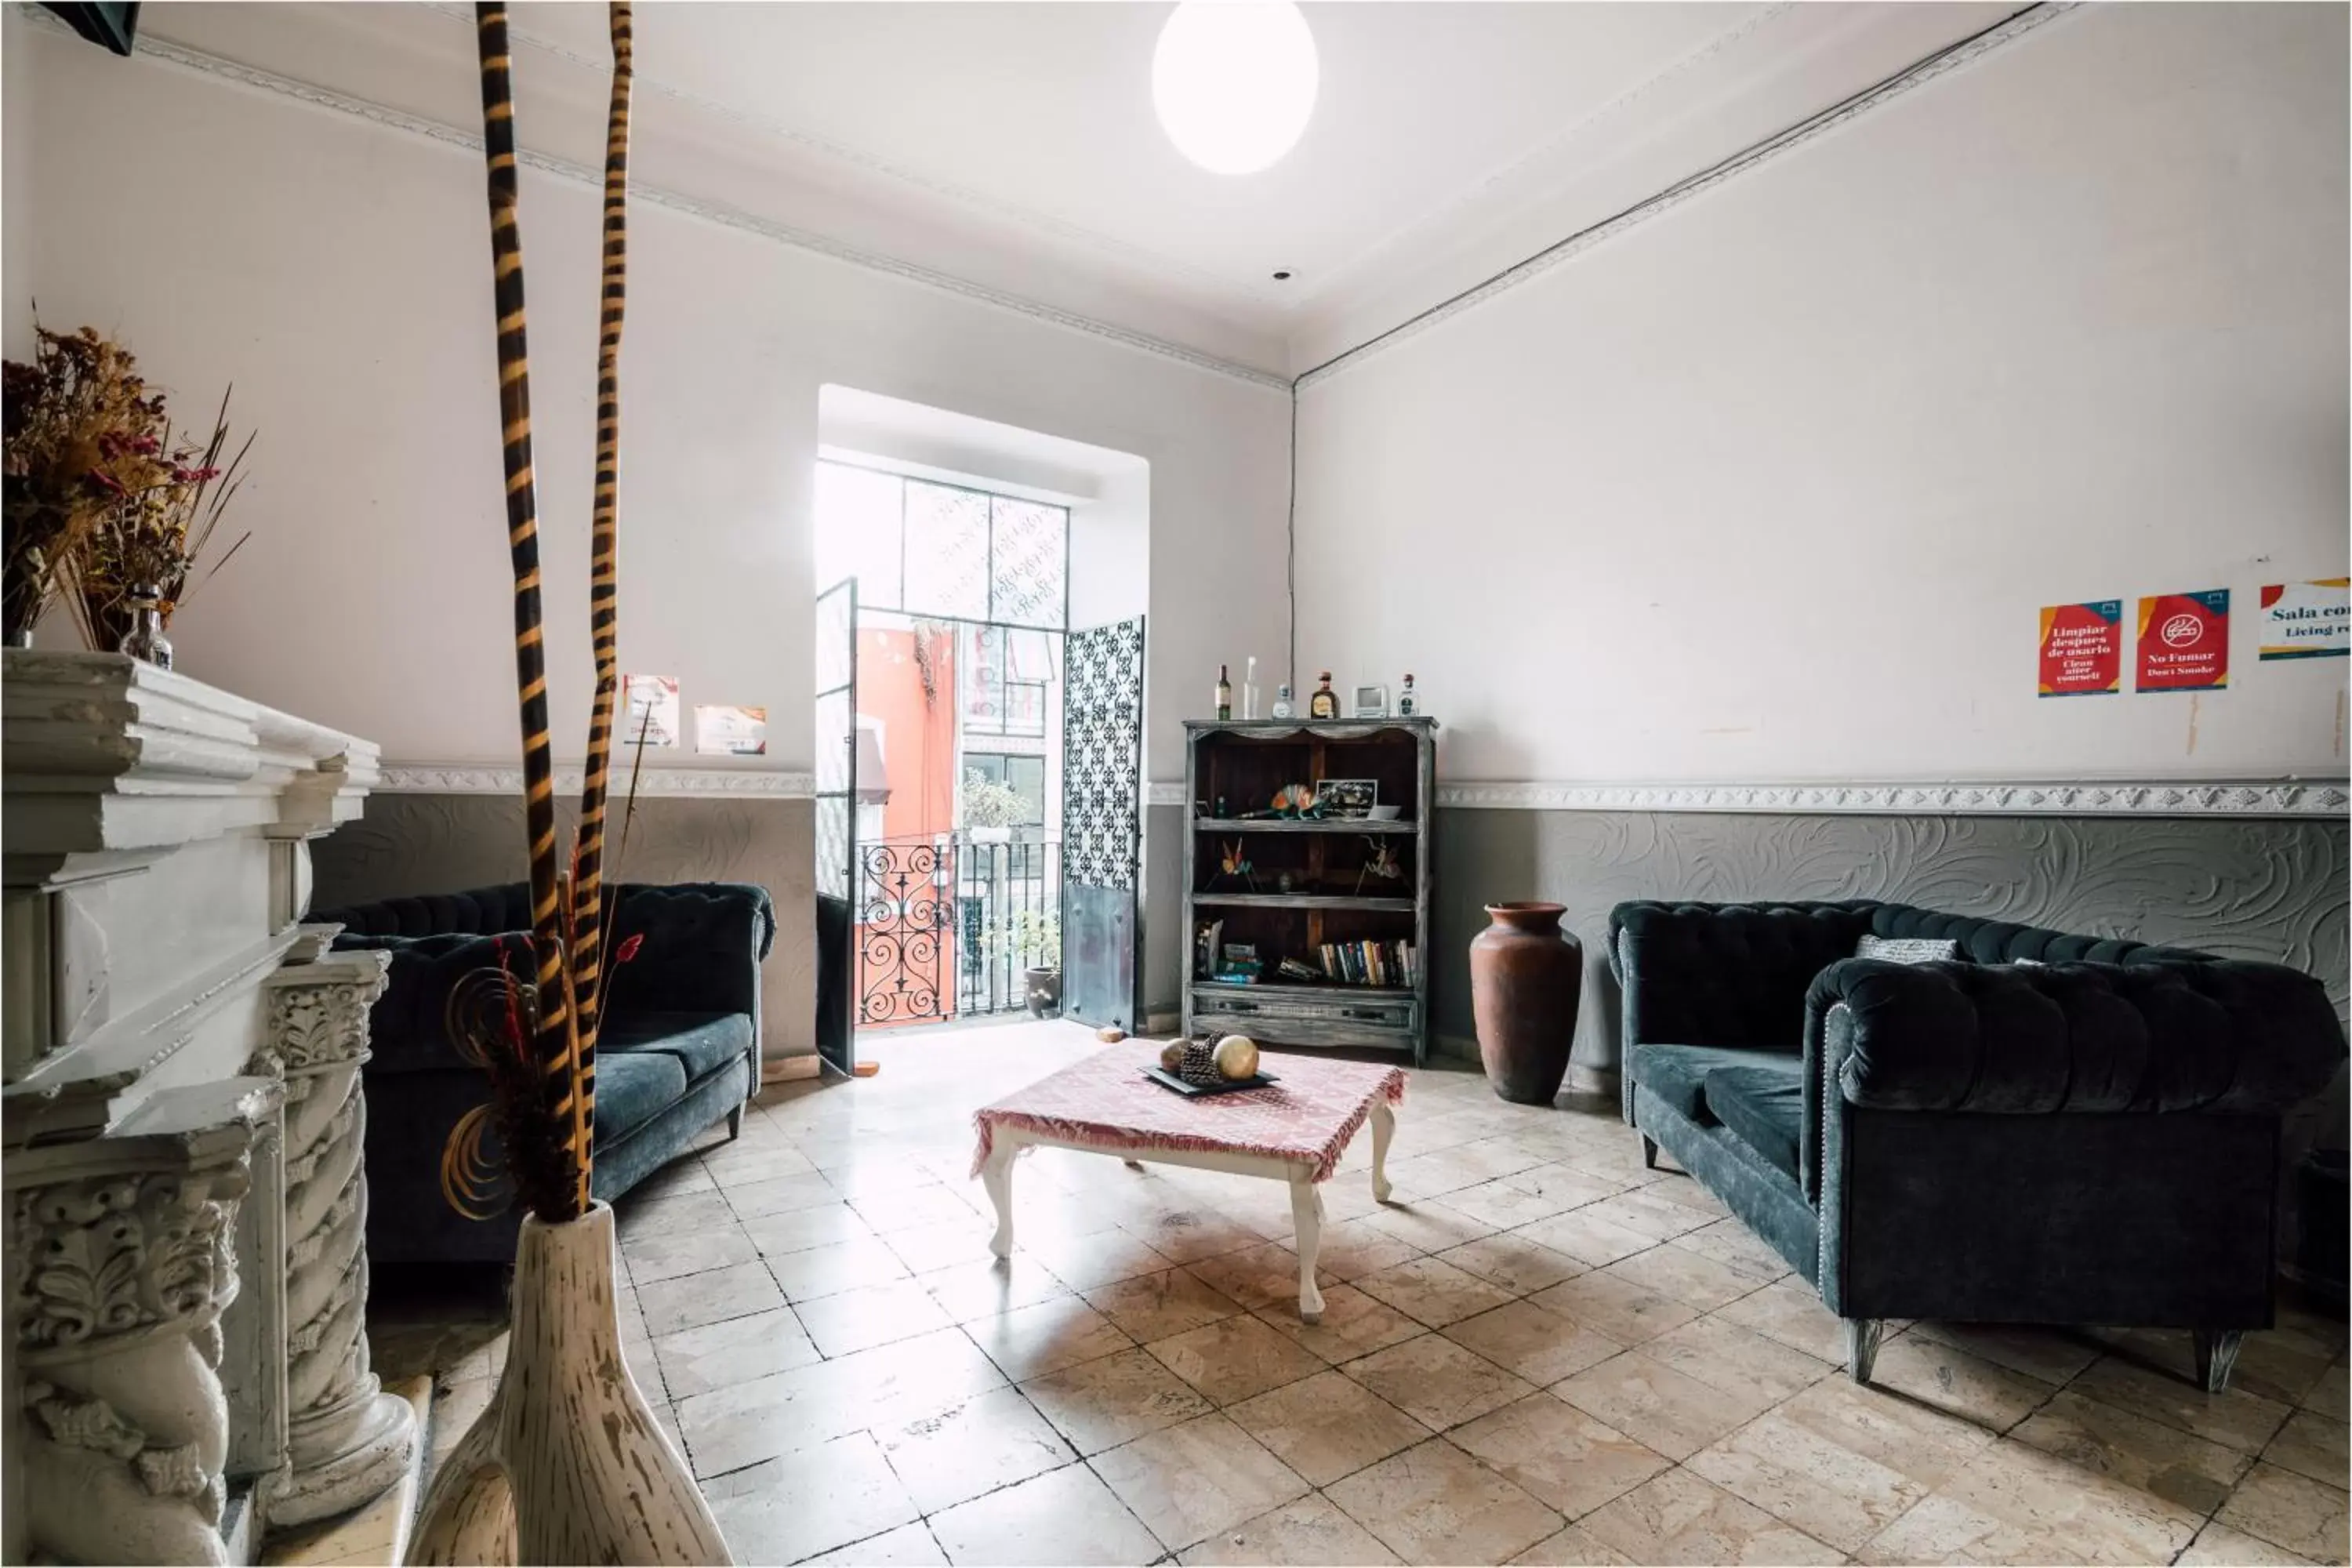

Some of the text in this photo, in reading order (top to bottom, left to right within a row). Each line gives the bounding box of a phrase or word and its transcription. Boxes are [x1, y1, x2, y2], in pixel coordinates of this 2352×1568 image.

[2272, 607, 2317, 621] Sala
[2053, 625, 2108, 637] Limpiar
[2286, 625, 2332, 639] Living
[2052, 637, 2107, 648] despues
[2048, 645, 2111, 659] de usarlo
[2149, 652, 2216, 664] No Fumar
[2063, 659, 2094, 668] Clean
[2176, 665, 2215, 675] Smoke
[2056, 672, 2100, 684] yourself
